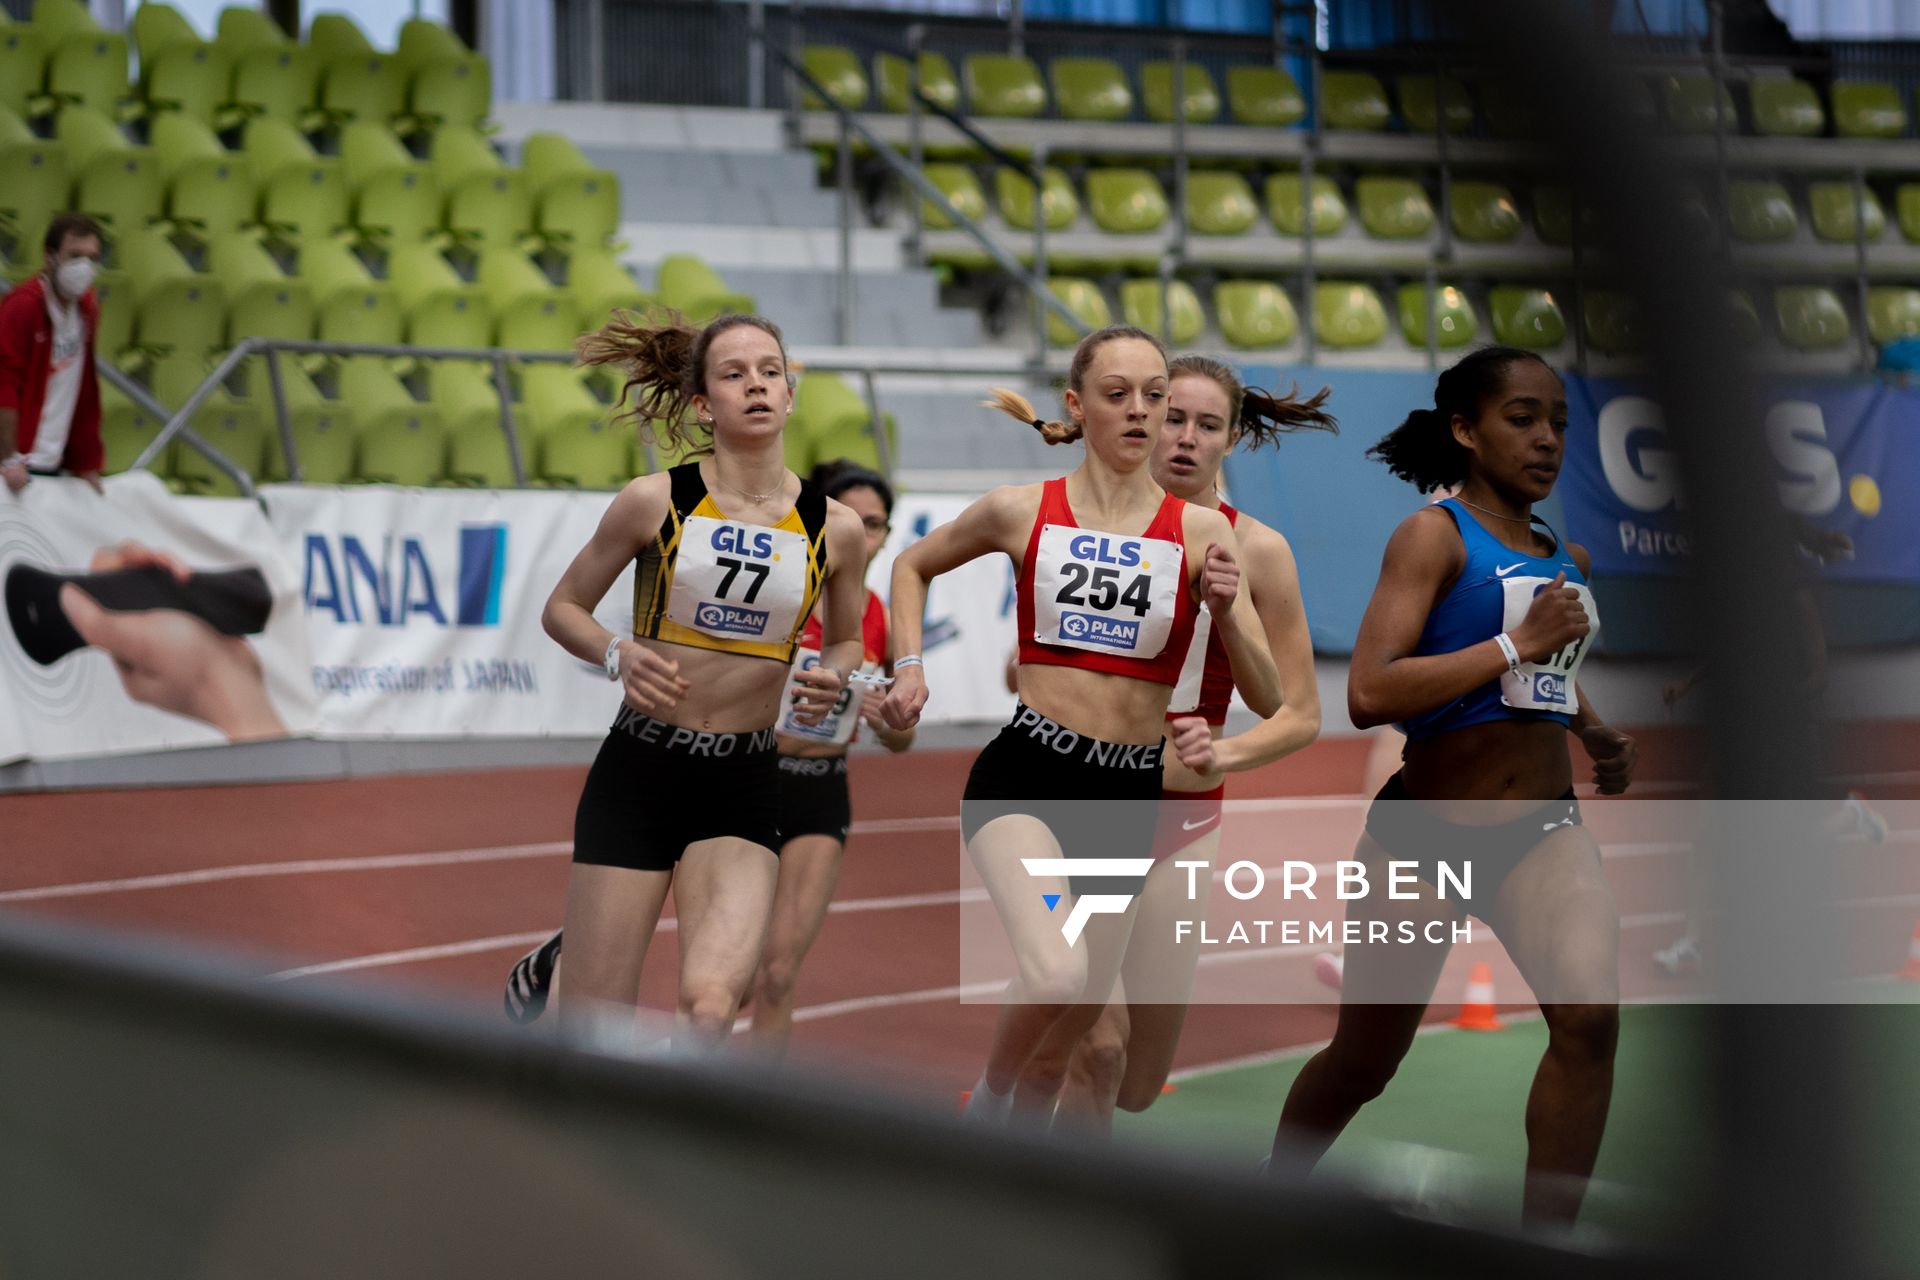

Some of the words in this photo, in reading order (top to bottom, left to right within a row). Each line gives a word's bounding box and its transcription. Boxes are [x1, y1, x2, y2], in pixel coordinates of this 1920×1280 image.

[304, 534, 448, 624] ANA
[714, 556, 770, 604] 77
[1056, 562, 1152, 617] 254
[726, 611, 765, 626] PLAN
[1090, 634, 1132, 646] INTERNATIONAL
[1091, 621, 1135, 640] PLAN
[614, 703, 667, 743] IKE
[666, 727, 737, 757] PRO
[1014, 707, 1079, 754] PRO
[1084, 739, 1160, 769] NIKE
